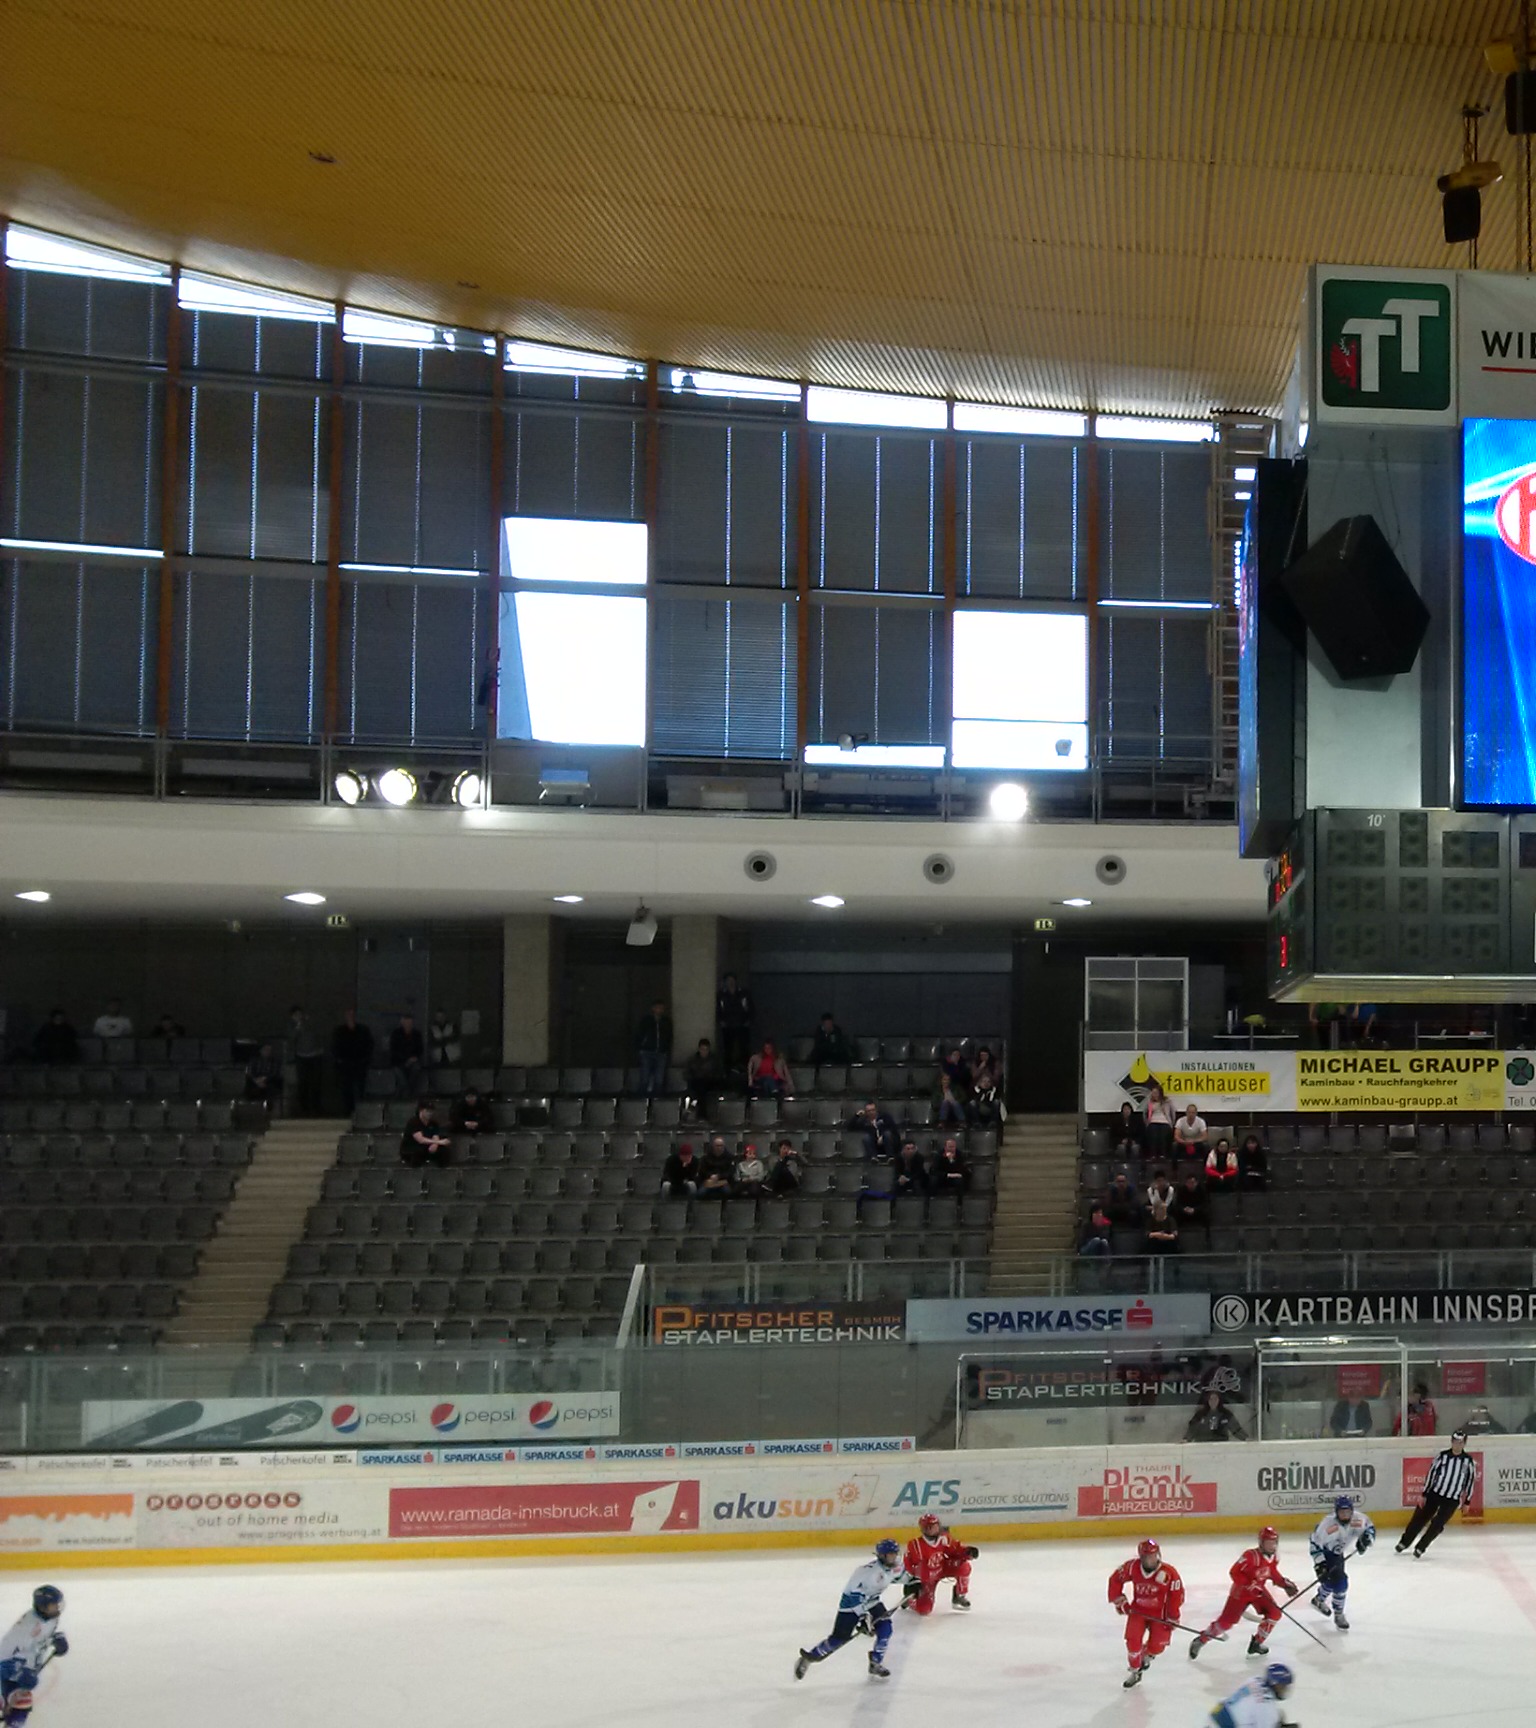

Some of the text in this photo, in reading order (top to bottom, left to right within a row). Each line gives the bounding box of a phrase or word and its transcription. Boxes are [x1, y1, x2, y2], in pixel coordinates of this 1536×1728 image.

[1181, 1062, 1256, 1072] INSTALLATIONEN
[1301, 1058, 1500, 1073] MICHAEL GRAUPP
[1166, 1073, 1267, 1093] fankhauser
[1301, 1078, 1458, 1088] Kaminbau Rauchfangkehrer
[1301, 1095, 1458, 1108] www.kaminbau-graupp.at
[1254, 1295, 1418, 1326] KARTBAHN
[655, 1305, 834, 1345] PFITSCHER
[966, 1308, 1123, 1335] SPARKASSE
[663, 1325, 901, 1346] STAPLERTECHNIK
[987, 1381, 1201, 1400] STAPLERTECHNIK
[365, 1410, 416, 1425] pepsi
[464, 1408, 514, 1423] pepsi
[563, 1405, 613, 1421] pepsi
[604, 1449, 664, 1459] SPARKASSE
[685, 1446, 744, 1456] SPARKASSE
[763, 1444, 822, 1454] SPARKASSE
[842, 1442, 900, 1452] SPARKASSE
[362, 1453, 422, 1464] SPARKASSE
[443, 1452, 504, 1462] SPARKASSE
[523, 1451, 584, 1461] SPARKASSE
[1135, 1465, 1172, 1473] THAUR
[1257, 1461, 1376, 1492] GRÜNLAND
[1104, 1465, 1194, 1500] Plank
[892, 1479, 1070, 1507] AFS LOGISTIC SOLUTIONS
[147, 1492, 302, 1511] progress
[713, 1492, 834, 1520] akusun
[1103, 1500, 1194, 1513] FAHRZEUGBAU
[197, 1511, 339, 1527] out of home media
[400, 1502, 619, 1523] www.ramada-innsbruck.at
